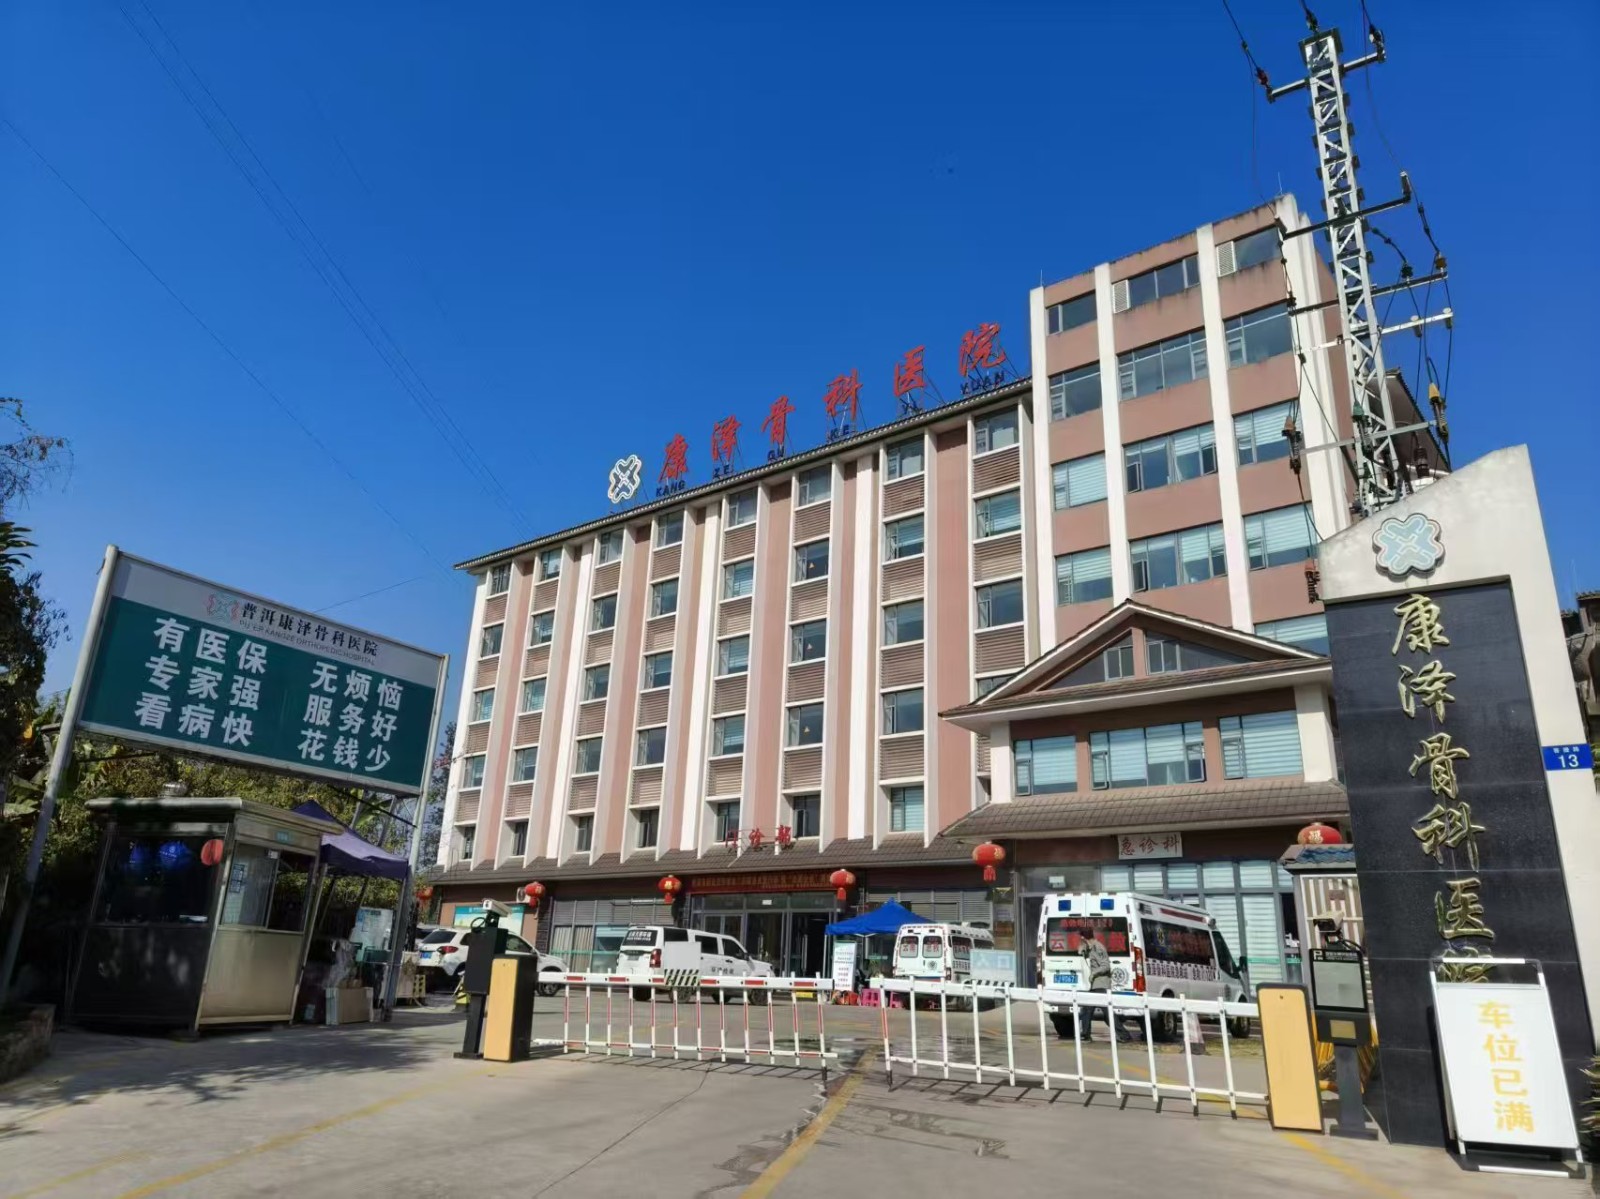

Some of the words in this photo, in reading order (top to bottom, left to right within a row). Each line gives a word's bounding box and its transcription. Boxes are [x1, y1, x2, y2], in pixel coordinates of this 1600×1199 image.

[659, 322, 1006, 482] 康泽骨科医院
[655, 479, 686, 498] KANG
[242, 602, 378, 657] 普洱康泽骨科医院
[341, 650, 376, 666] HOSPITAL
[145, 654, 262, 712] 专家强
[303, 693, 398, 742] 服务好
[153, 617, 268, 675] 有医保
[310, 661, 404, 712] 无烦恼
[134, 691, 254, 747] 看病快
[297, 727, 392, 772] 花钱少
[1558, 754, 1579, 768] 13
[1120, 834, 1180, 855] 急诊科
[1477, 1000, 1535, 1133] 车位已满
